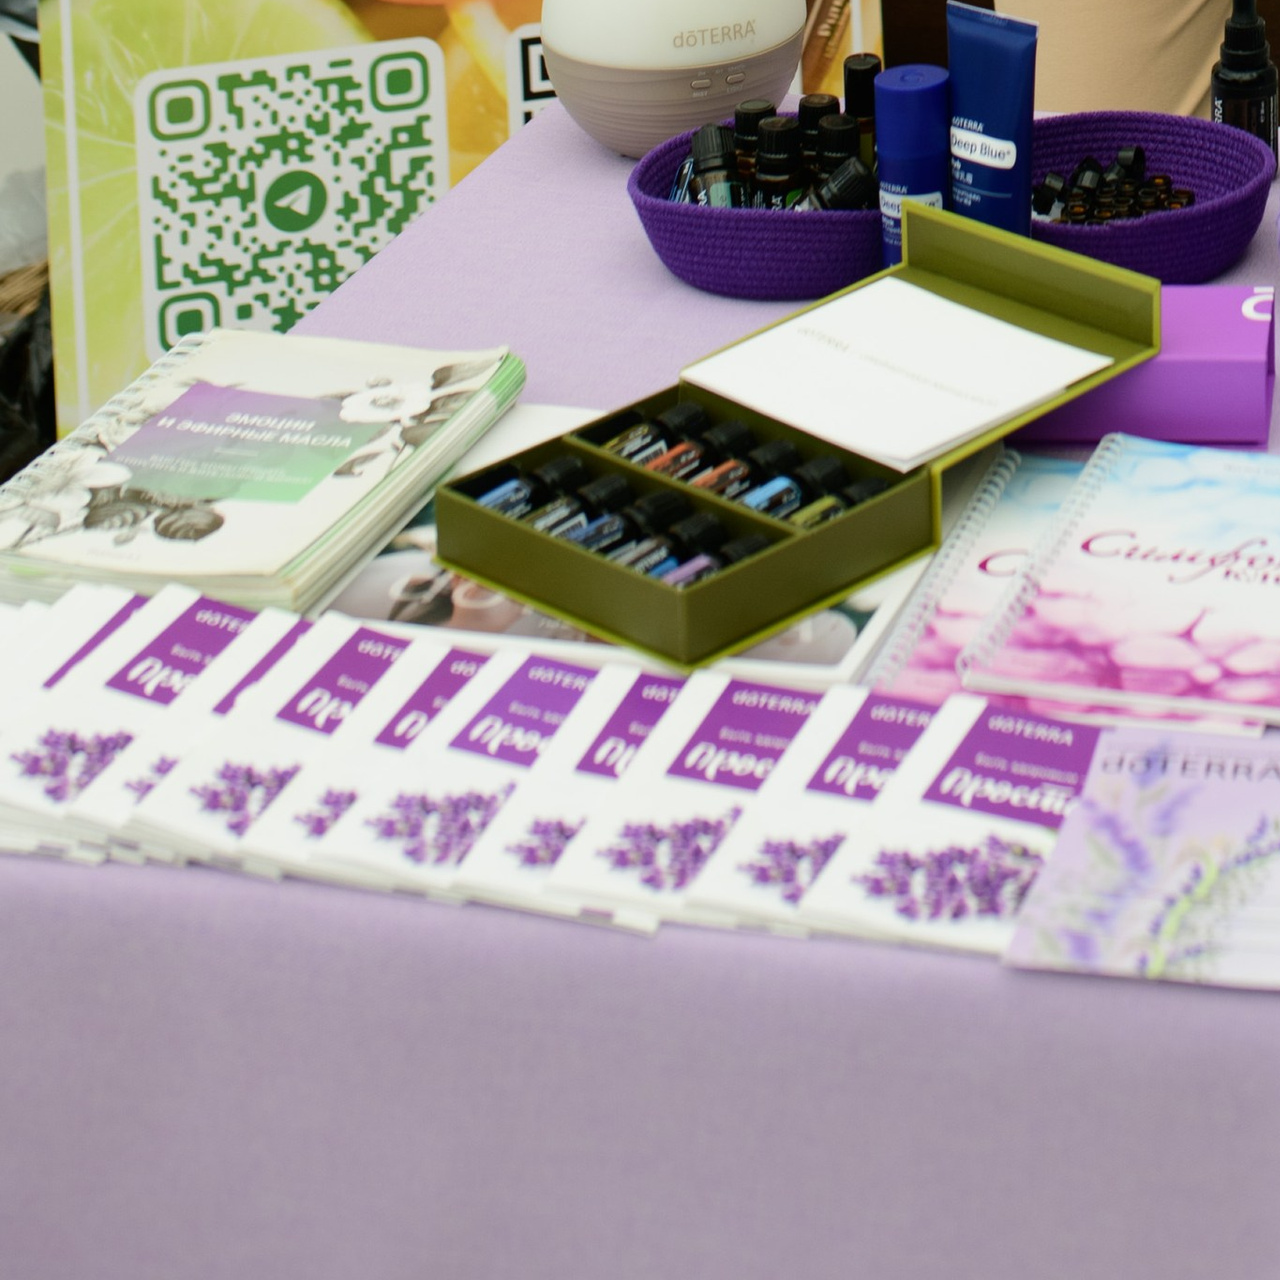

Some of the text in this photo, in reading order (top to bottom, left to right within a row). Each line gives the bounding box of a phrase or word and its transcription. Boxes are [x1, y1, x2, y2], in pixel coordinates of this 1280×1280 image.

[673, 20, 756, 48] dōTERRA
[176, 419, 274, 443] ЭФИРНЫЕ
[279, 432, 353, 449] МАСЛА
[225, 412, 316, 431] ЭМОЦИИ
